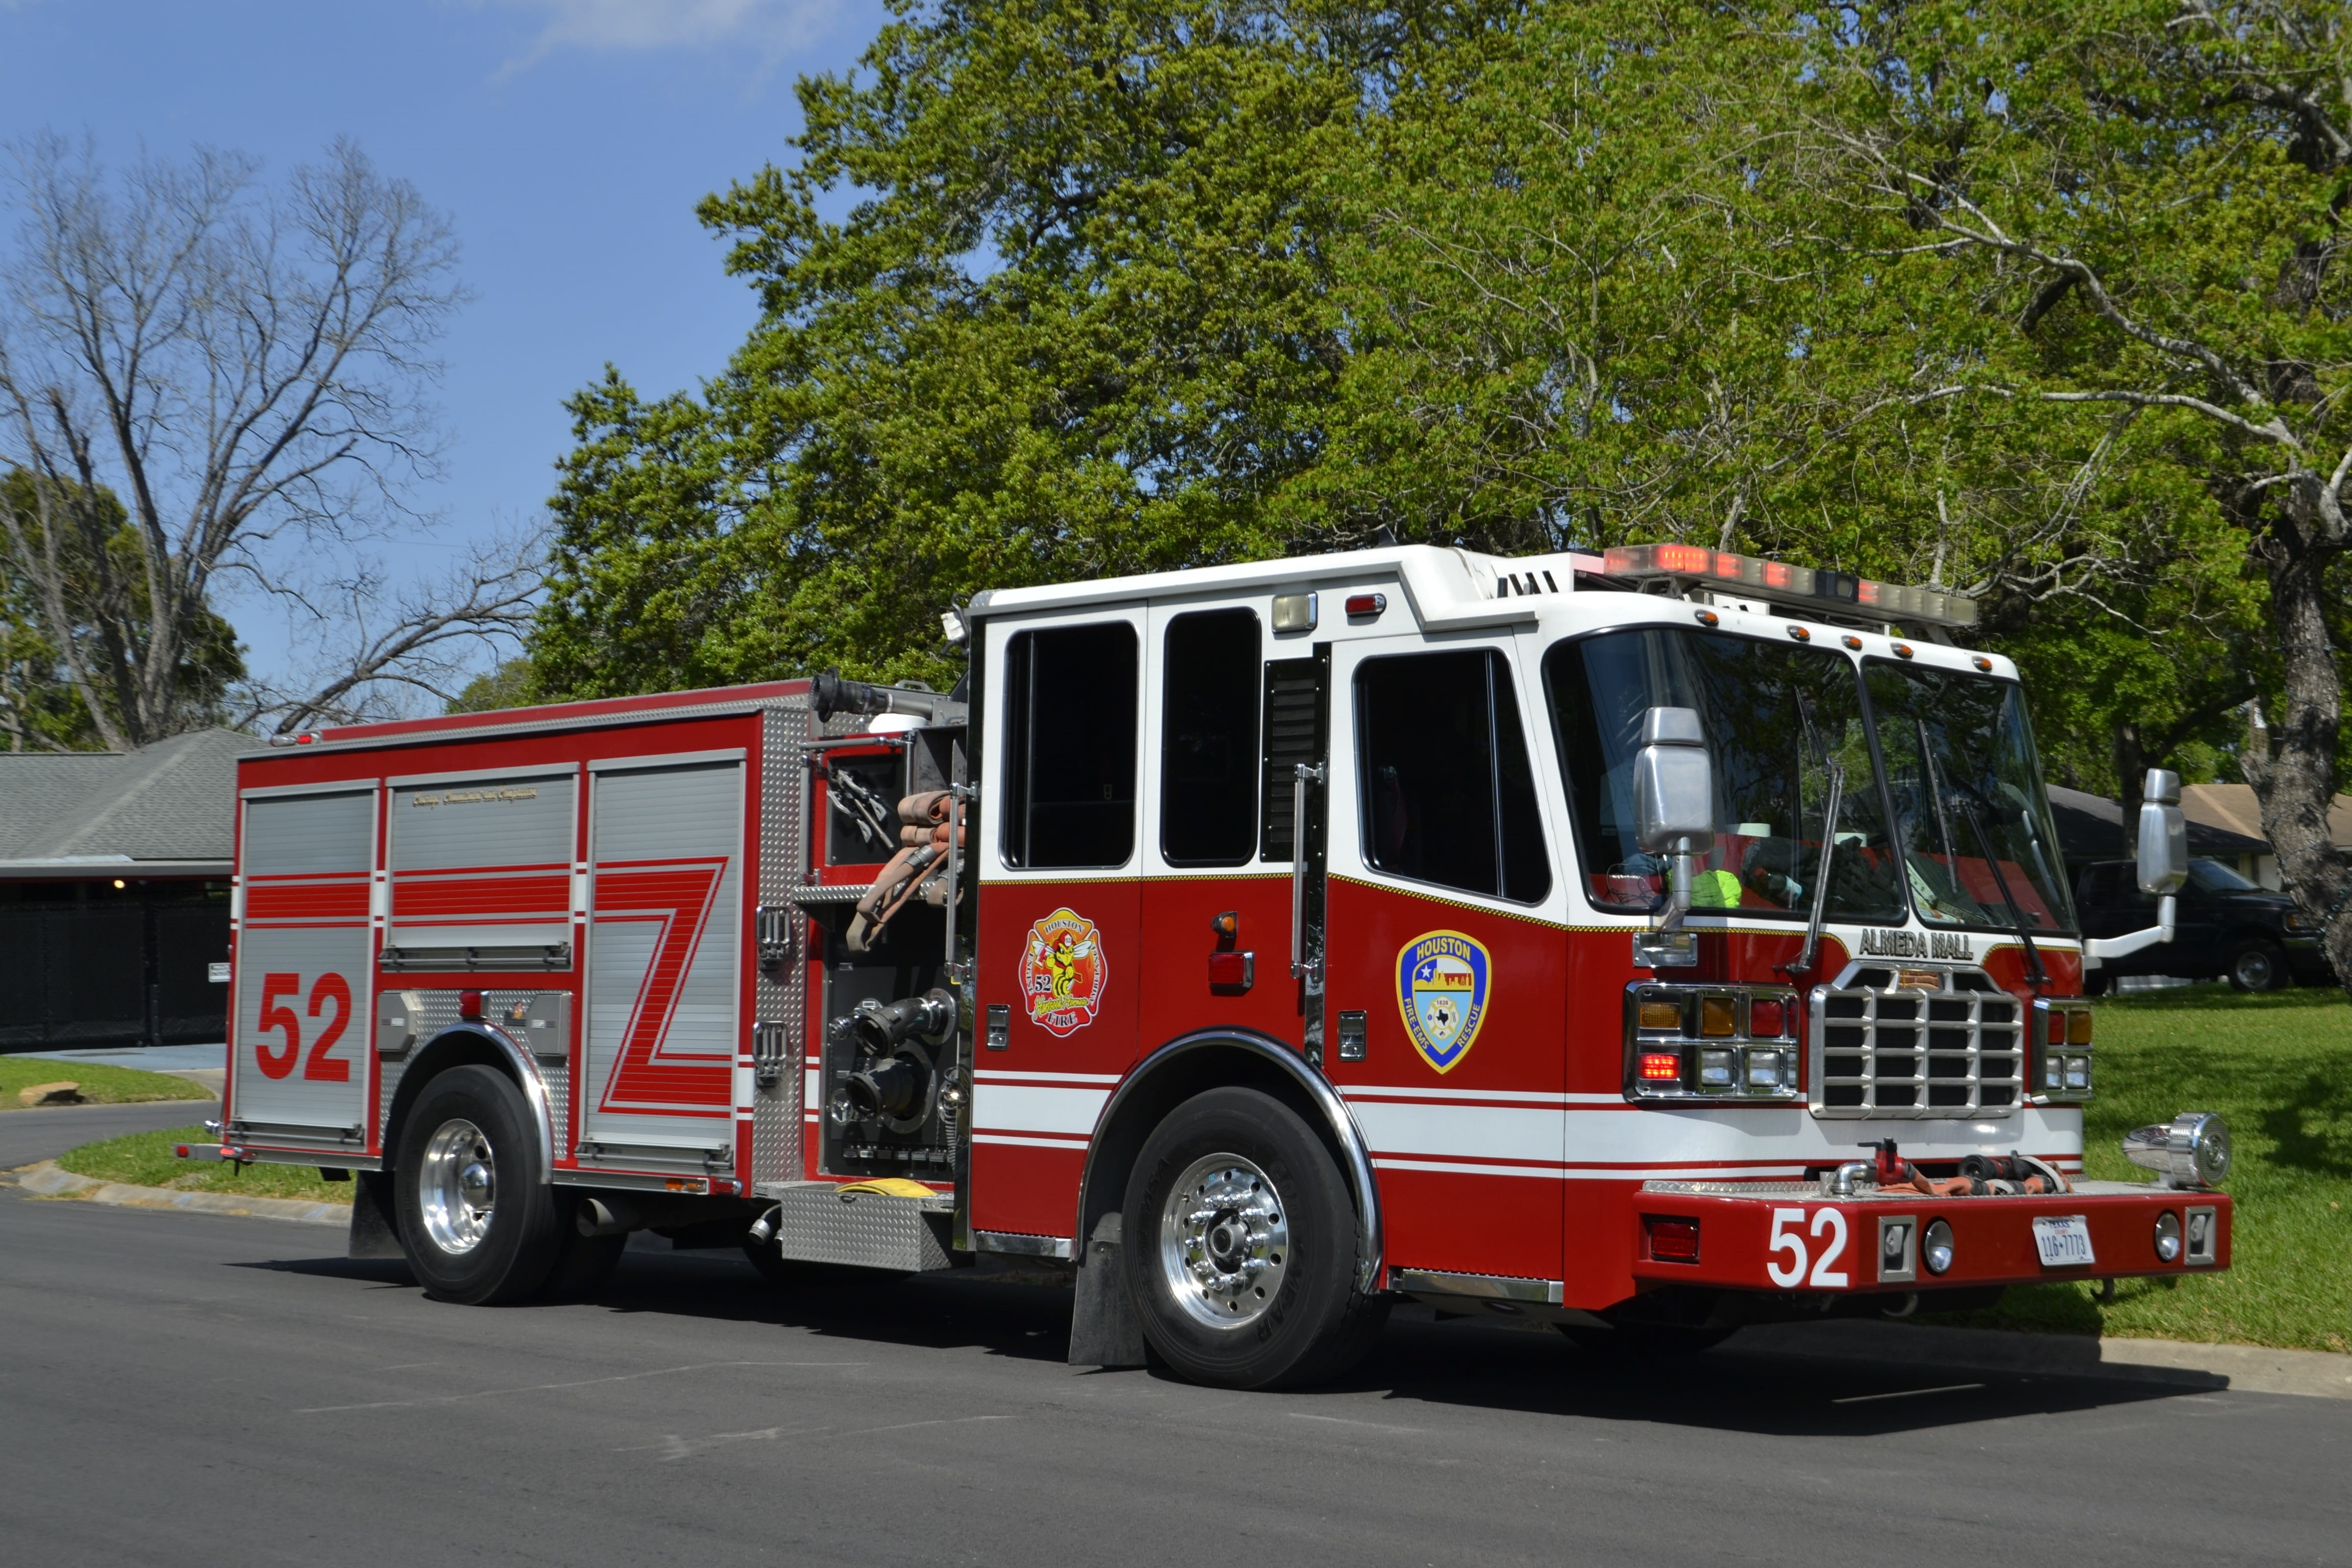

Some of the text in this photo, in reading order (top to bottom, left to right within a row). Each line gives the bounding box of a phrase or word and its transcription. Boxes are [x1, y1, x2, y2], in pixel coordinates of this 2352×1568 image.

[1045, 920, 1084, 934] HOUSTON
[1417, 938, 1471, 961] HOUSTON
[1859, 928, 1973, 960] ALMEDA MALL
[1025, 952, 1034, 995] ENGINE
[1035, 975, 1051, 992] 52
[255, 972, 351, 1082] 52
[1046, 1012, 1077, 1026] FIRE
[1404, 998, 1430, 1049] FIRE-EMS
[1457, 1004, 1481, 1047] RESCUE
[2048, 1220, 2070, 1228] TEXAS
[1767, 1207, 1848, 1287] 52
